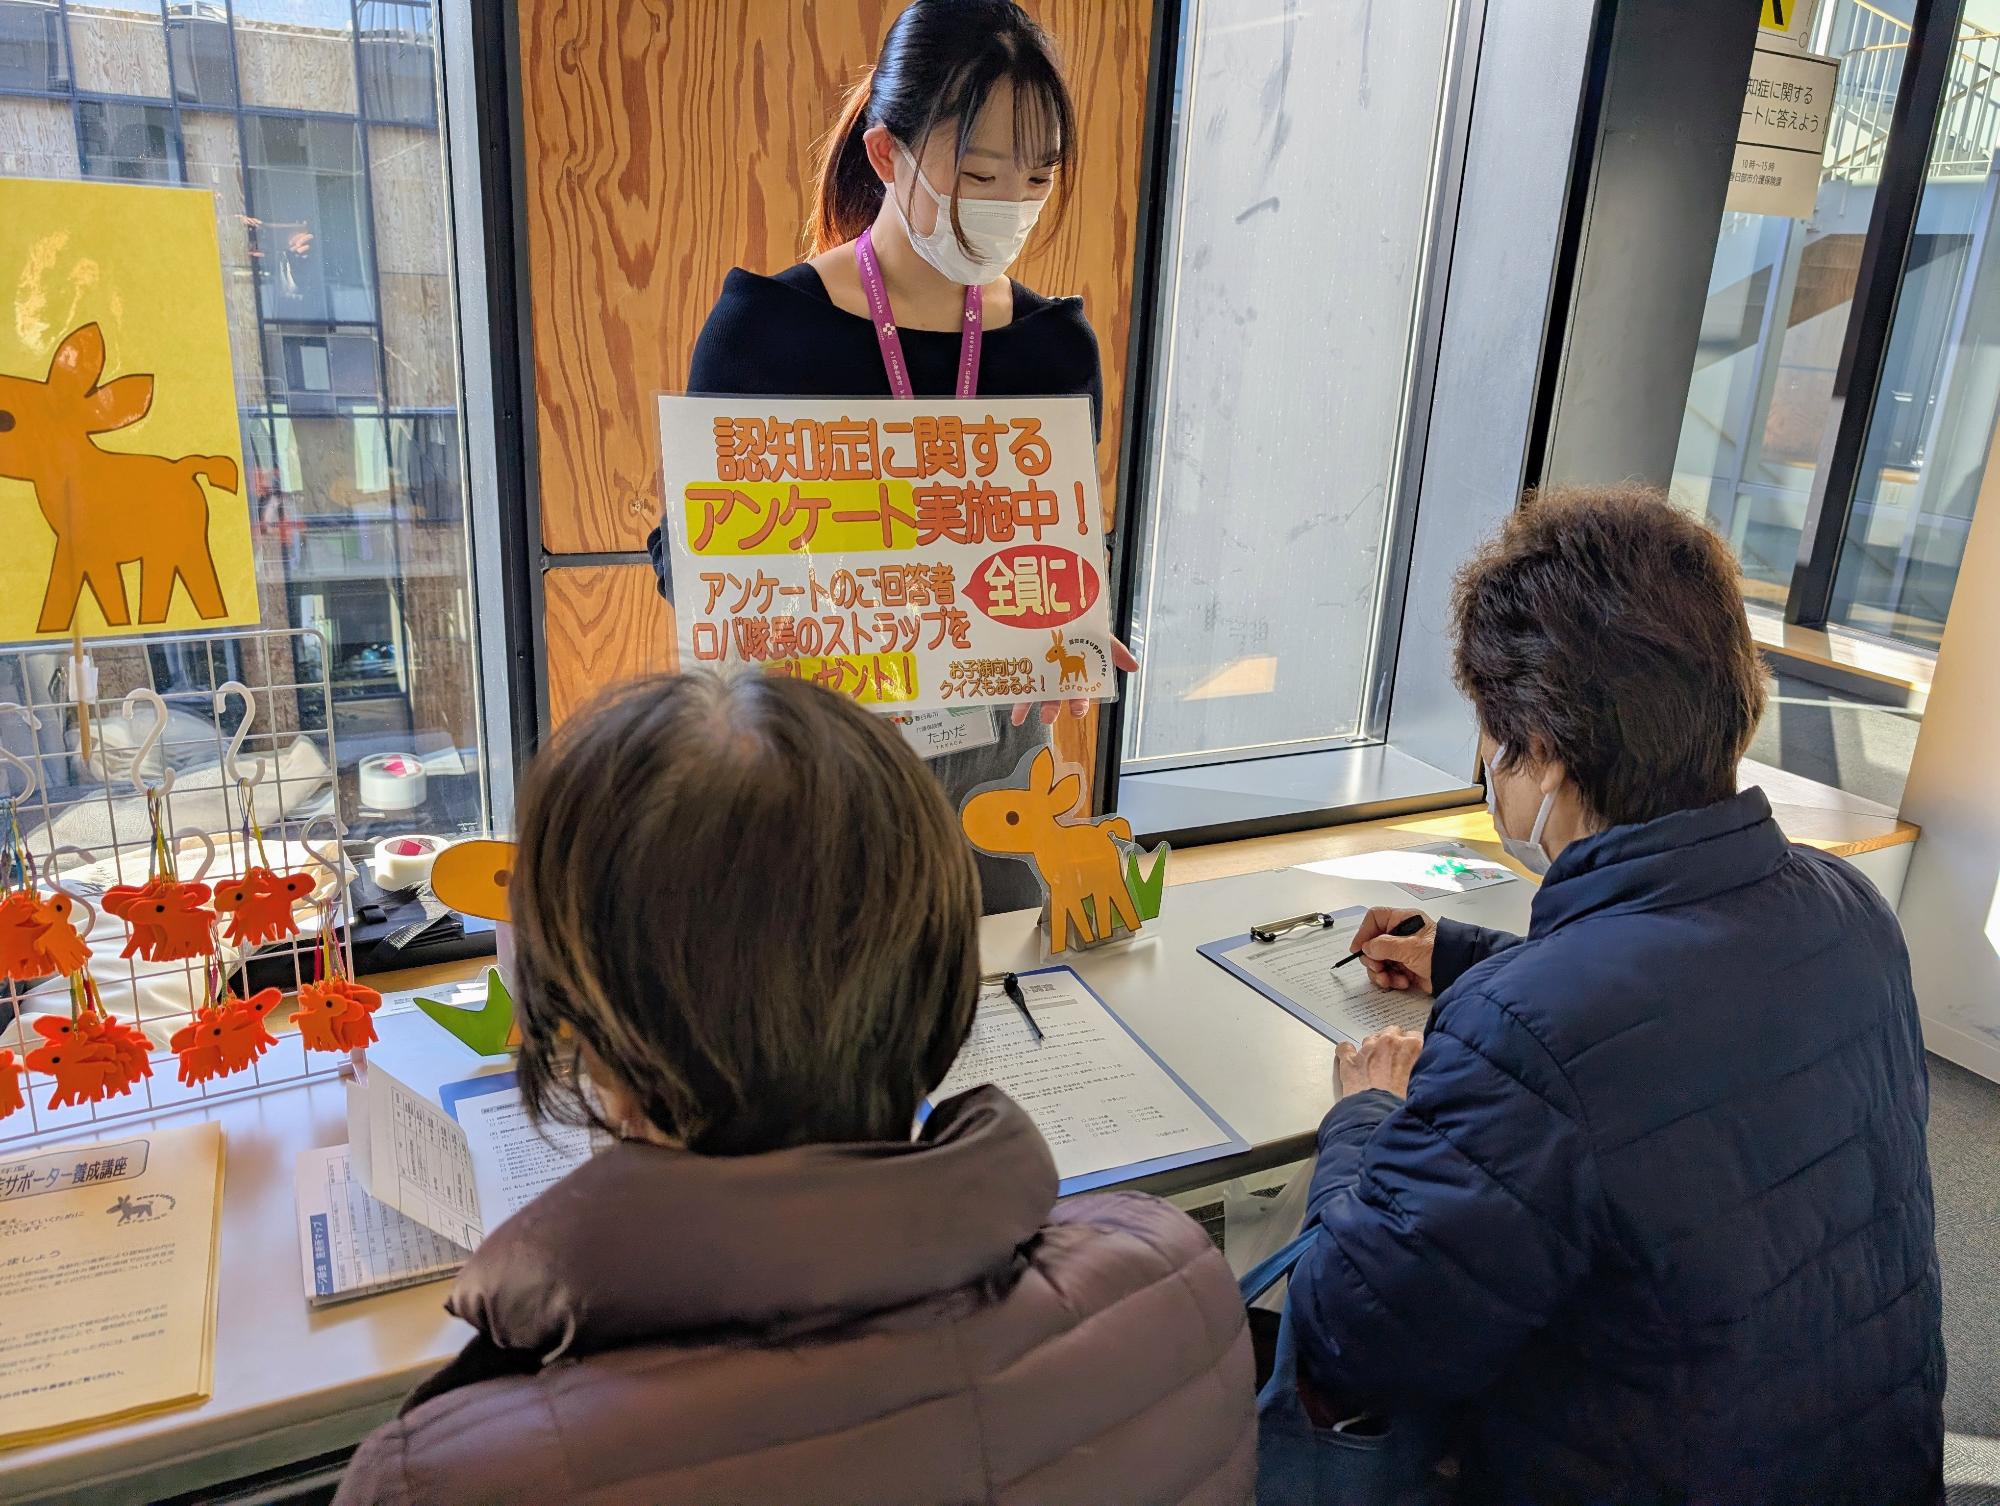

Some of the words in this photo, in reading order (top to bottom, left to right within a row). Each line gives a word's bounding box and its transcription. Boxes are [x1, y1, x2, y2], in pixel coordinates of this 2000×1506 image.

[712, 415, 1053, 482] 認知症に関する
[684, 479, 1089, 551] アンケート実施中！
[699, 562, 956, 616] アンケートのご回答者
[984, 554, 1088, 617] 全員に！
[692, 606, 972, 663] ロバ隊長のストラップを
[939, 673, 1047, 699] クイズもあるよ！
[949, 657, 1034, 680] お子様向けの
[1059, 681, 1102, 693] caravan
[927, 723, 968, 745] たかだ
